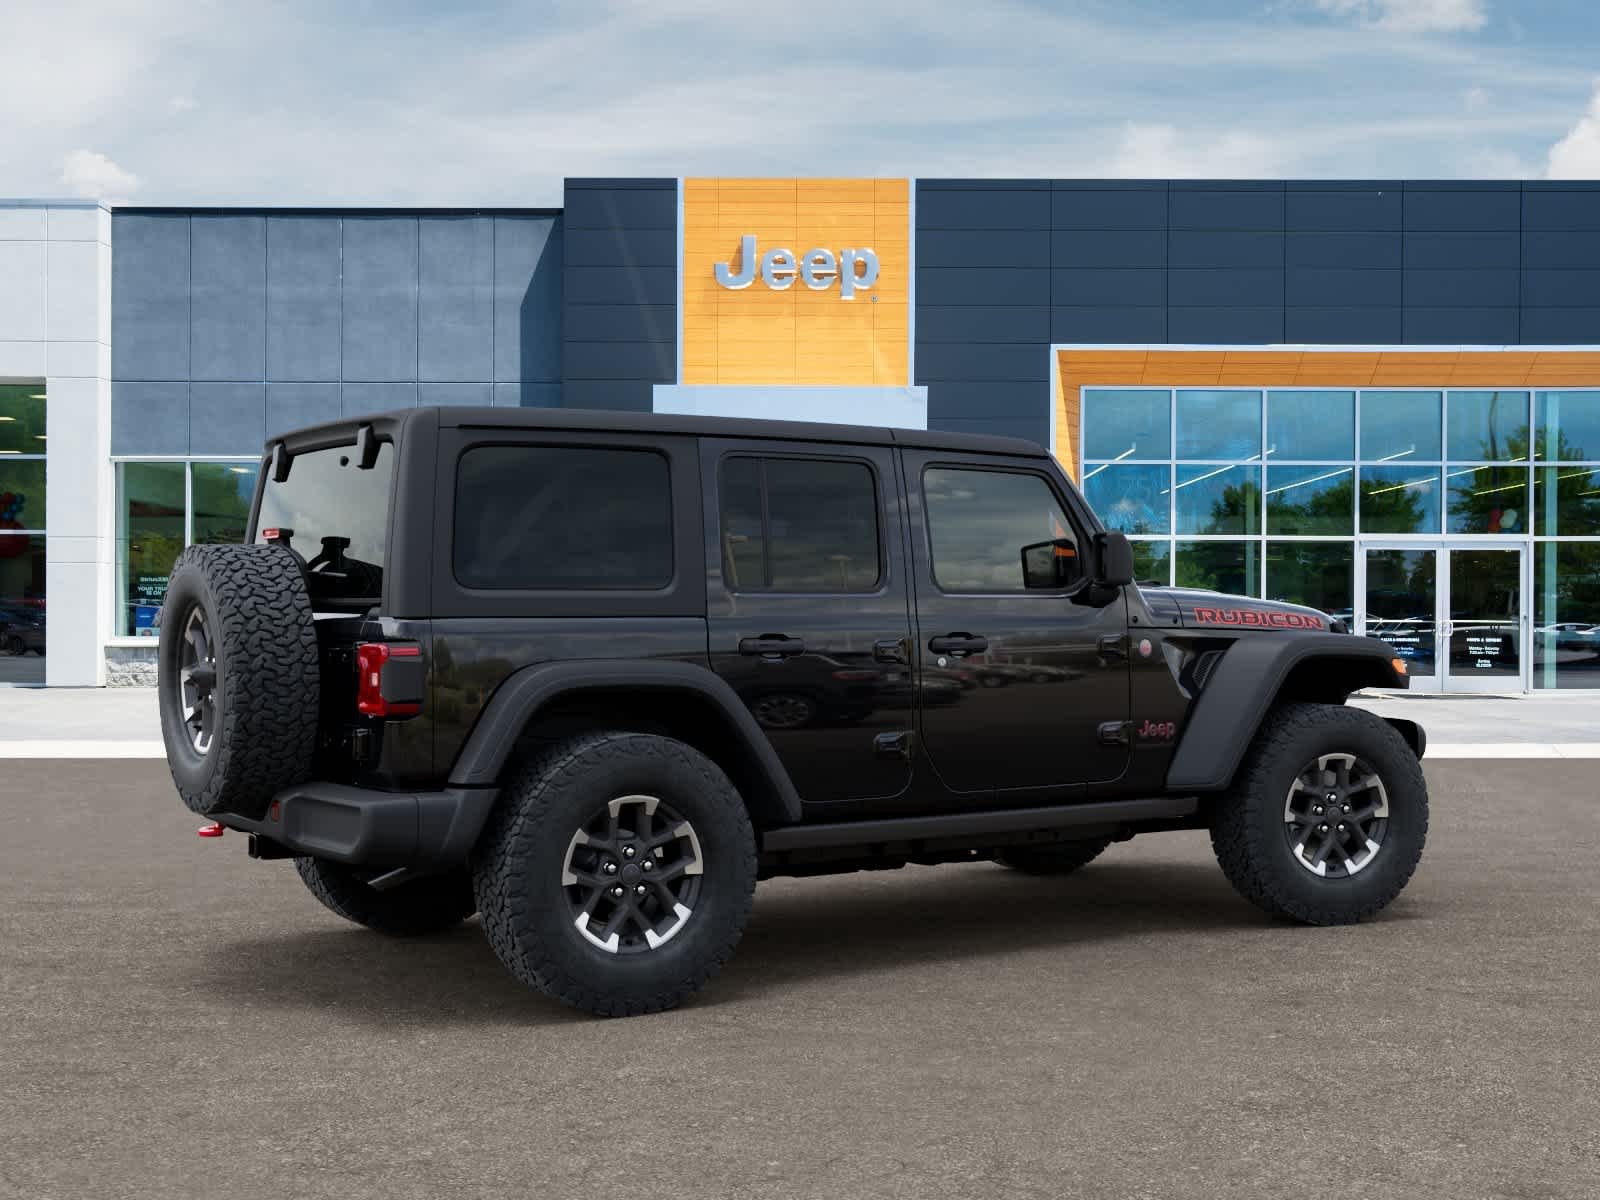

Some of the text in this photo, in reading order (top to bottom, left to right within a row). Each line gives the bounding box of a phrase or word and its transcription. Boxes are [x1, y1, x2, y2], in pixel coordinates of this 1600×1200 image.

[713, 234, 880, 300] Jeep
[1193, 606, 1325, 630] RUBICON
[1136, 719, 1176, 739] Jeep
